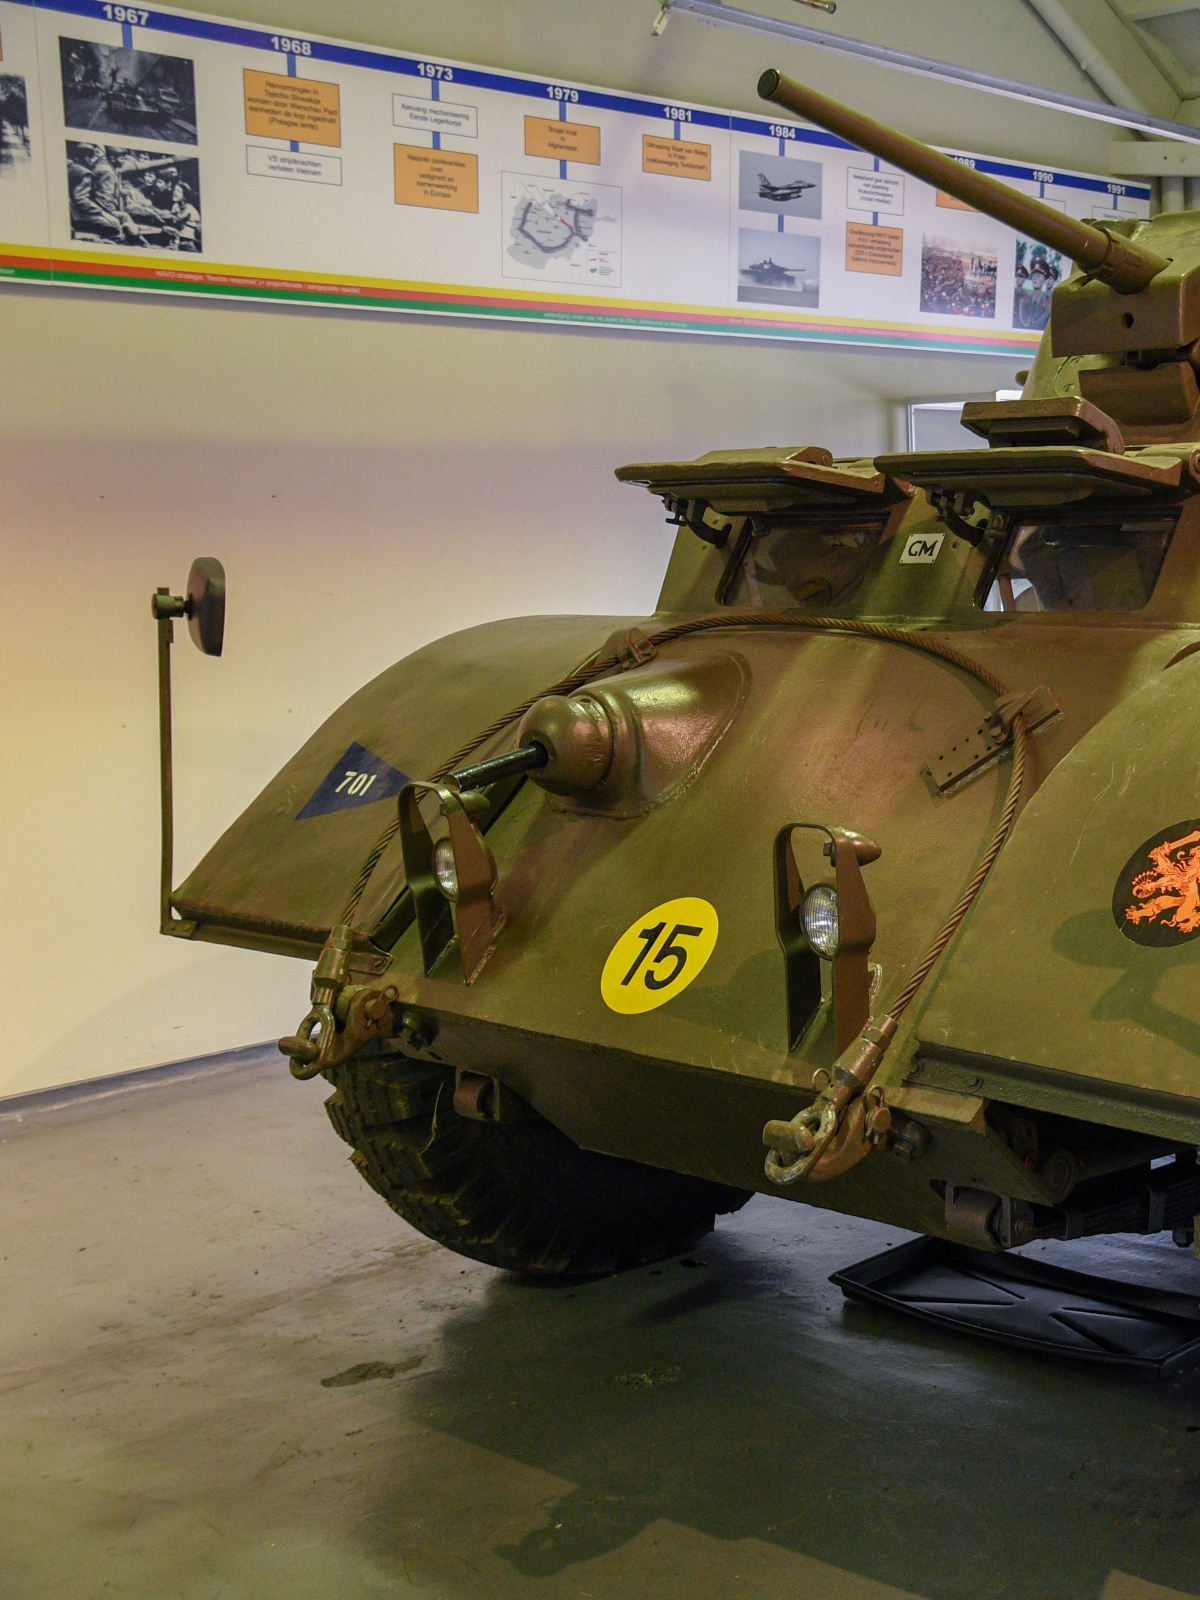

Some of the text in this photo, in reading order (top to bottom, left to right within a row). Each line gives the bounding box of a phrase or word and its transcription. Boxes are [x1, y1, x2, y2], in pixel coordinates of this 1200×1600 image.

[103, 4, 149, 26] 1967
[271, 36, 312, 57] 1968
[417, 62, 454, 81] 1973
[547, 86, 579, 103] 1979
[663, 106, 692, 122] 1981
[768, 125, 796, 139] 1984
[267, 154, 278, 162] VS
[1032, 170, 1054, 183] 1990
[1106, 184, 1126, 195] 1991
[908, 540, 939, 557] GM
[335, 770, 378, 797] 701
[620, 921, 704, 991] 15
